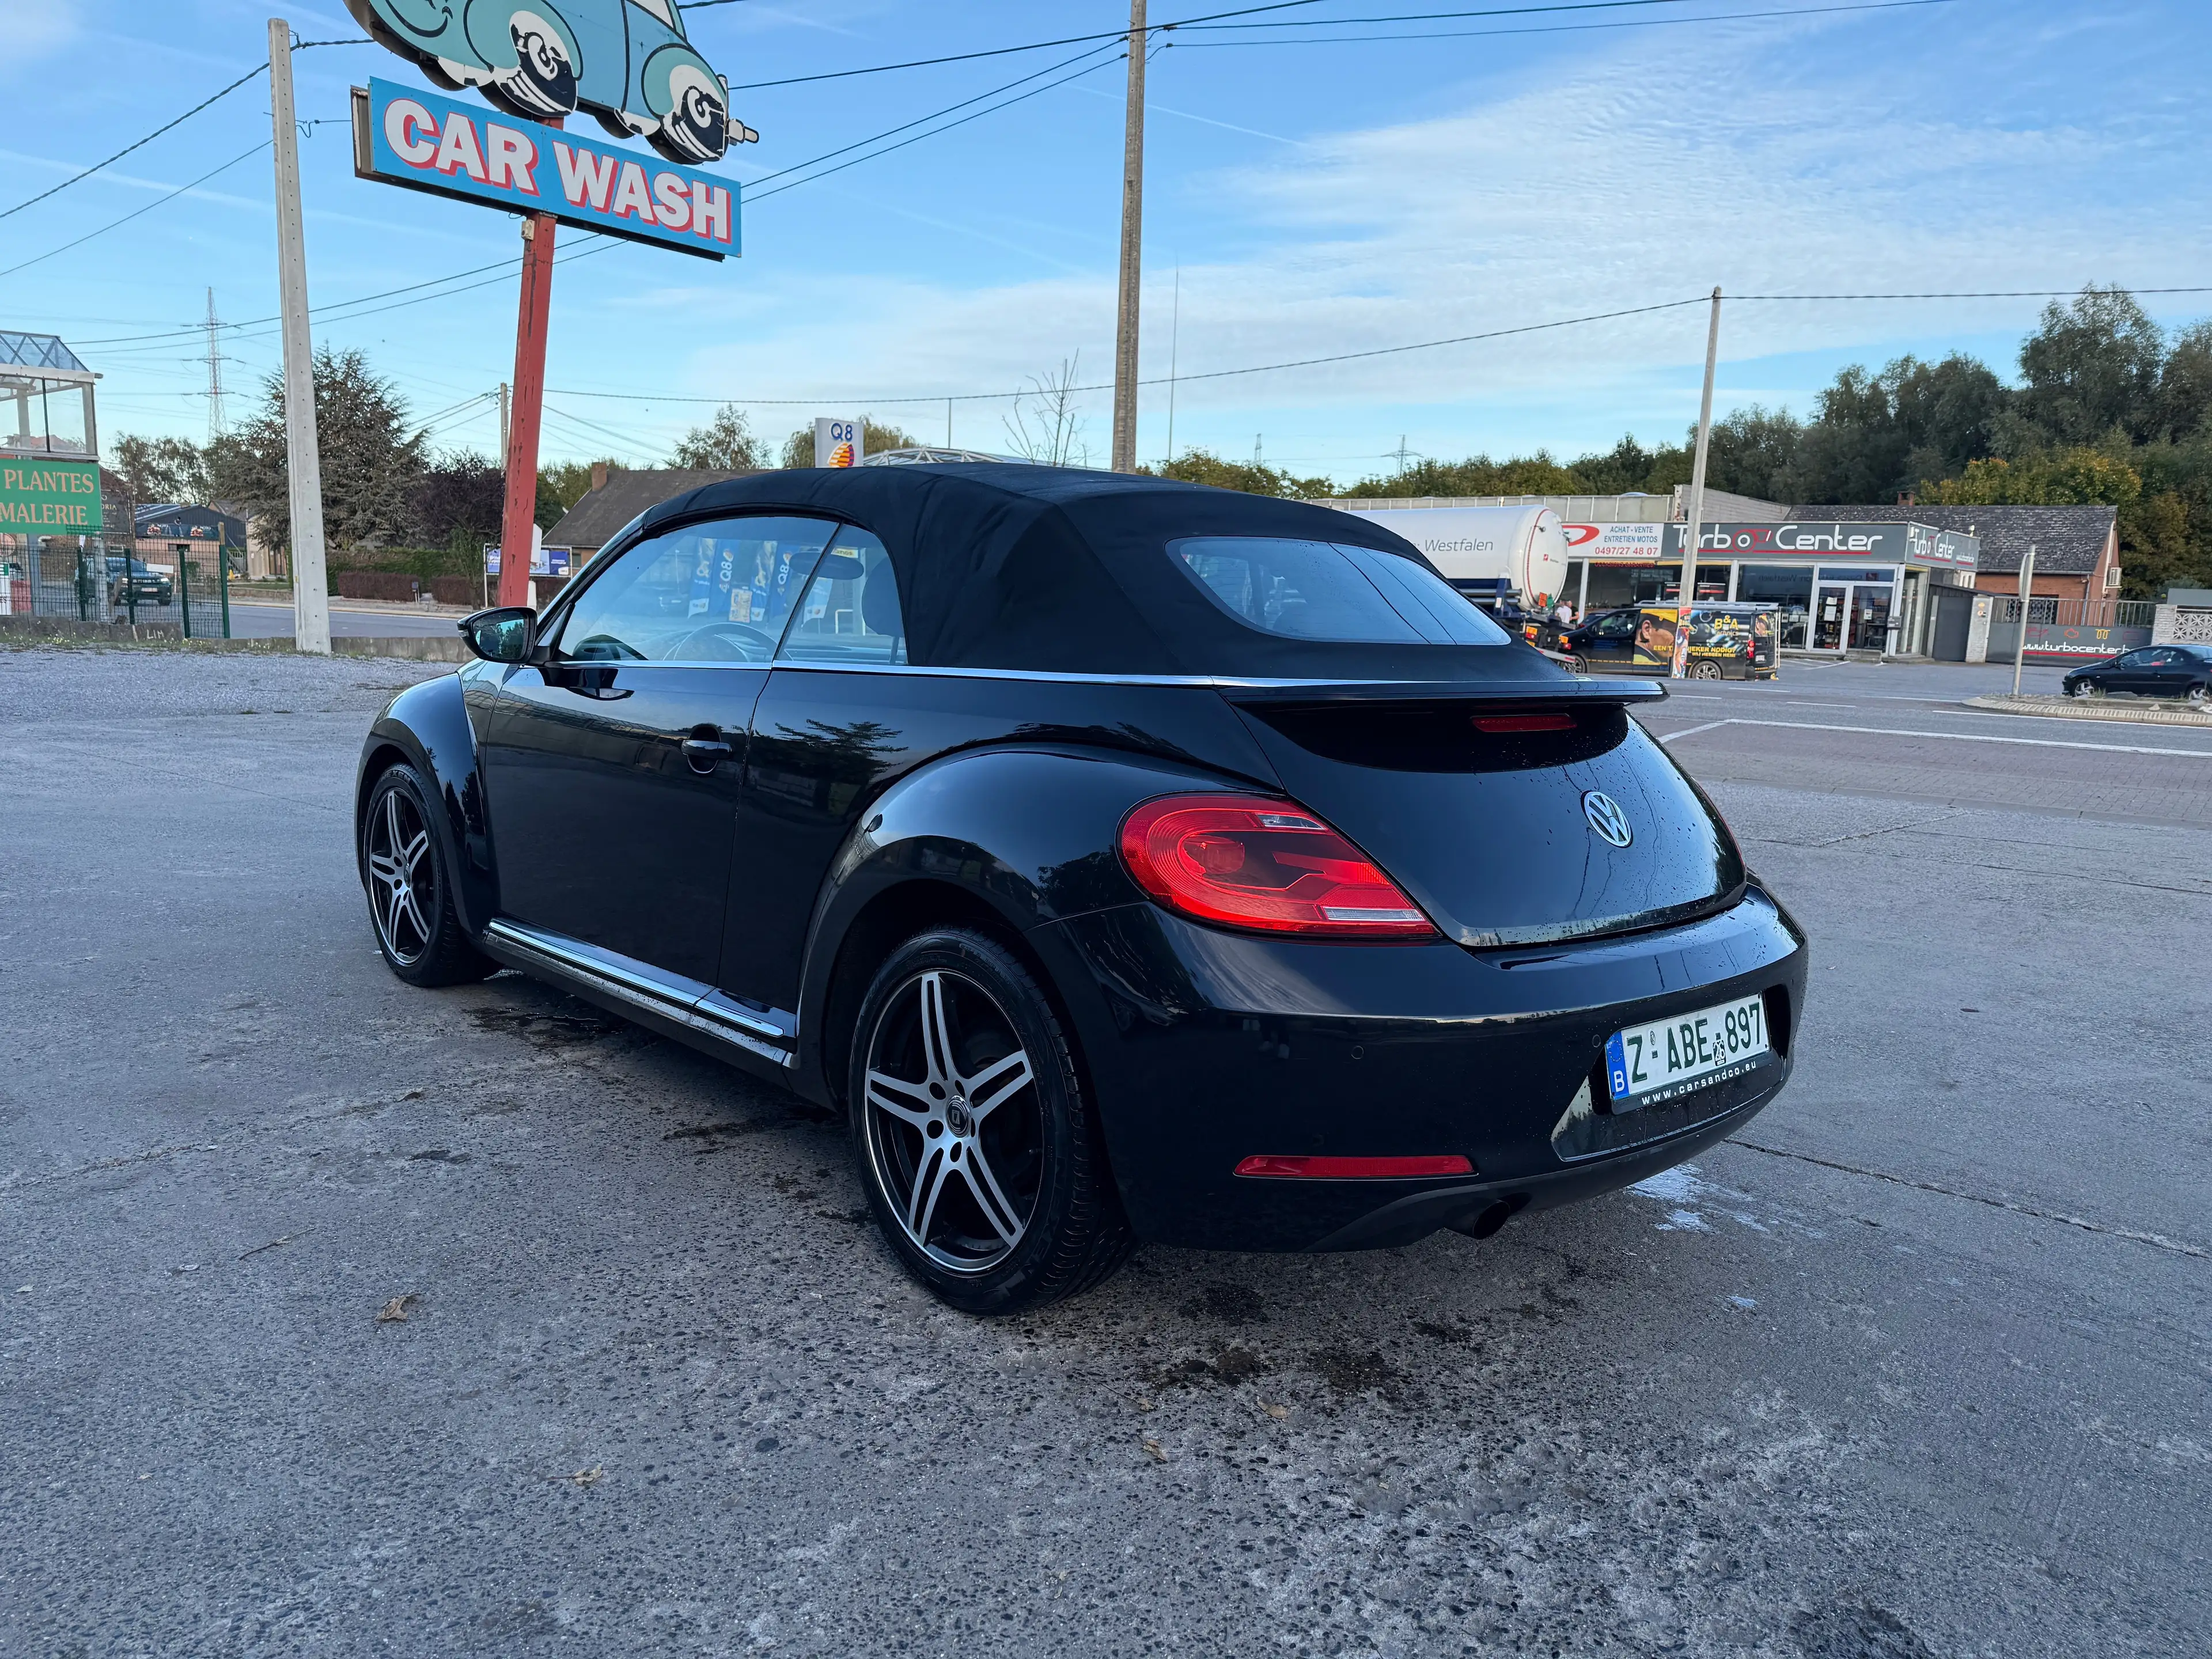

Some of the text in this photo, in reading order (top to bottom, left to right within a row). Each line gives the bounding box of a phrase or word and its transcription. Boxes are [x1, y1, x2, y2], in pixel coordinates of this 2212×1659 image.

[384, 98, 733, 244] CAR WASH
[831, 422, 853, 442] Q8
[3, 469, 94, 494] PLANTES
[0, 502, 88, 525] MALERIE
[1425, 538, 1494, 552] Westfalen
[1775, 524, 1883, 551] Center
[1934, 533, 1955, 559] Center
[1594, 547, 1658, 555] 0497/27 48 07
[720, 561, 733, 582] Q8
[778, 564, 790, 585] Q8
[1714, 615, 1738, 630] B&A
[1613, 1070, 1625, 1092] B
[1642, 1060, 1757, 1105] www.carsandco.eu
